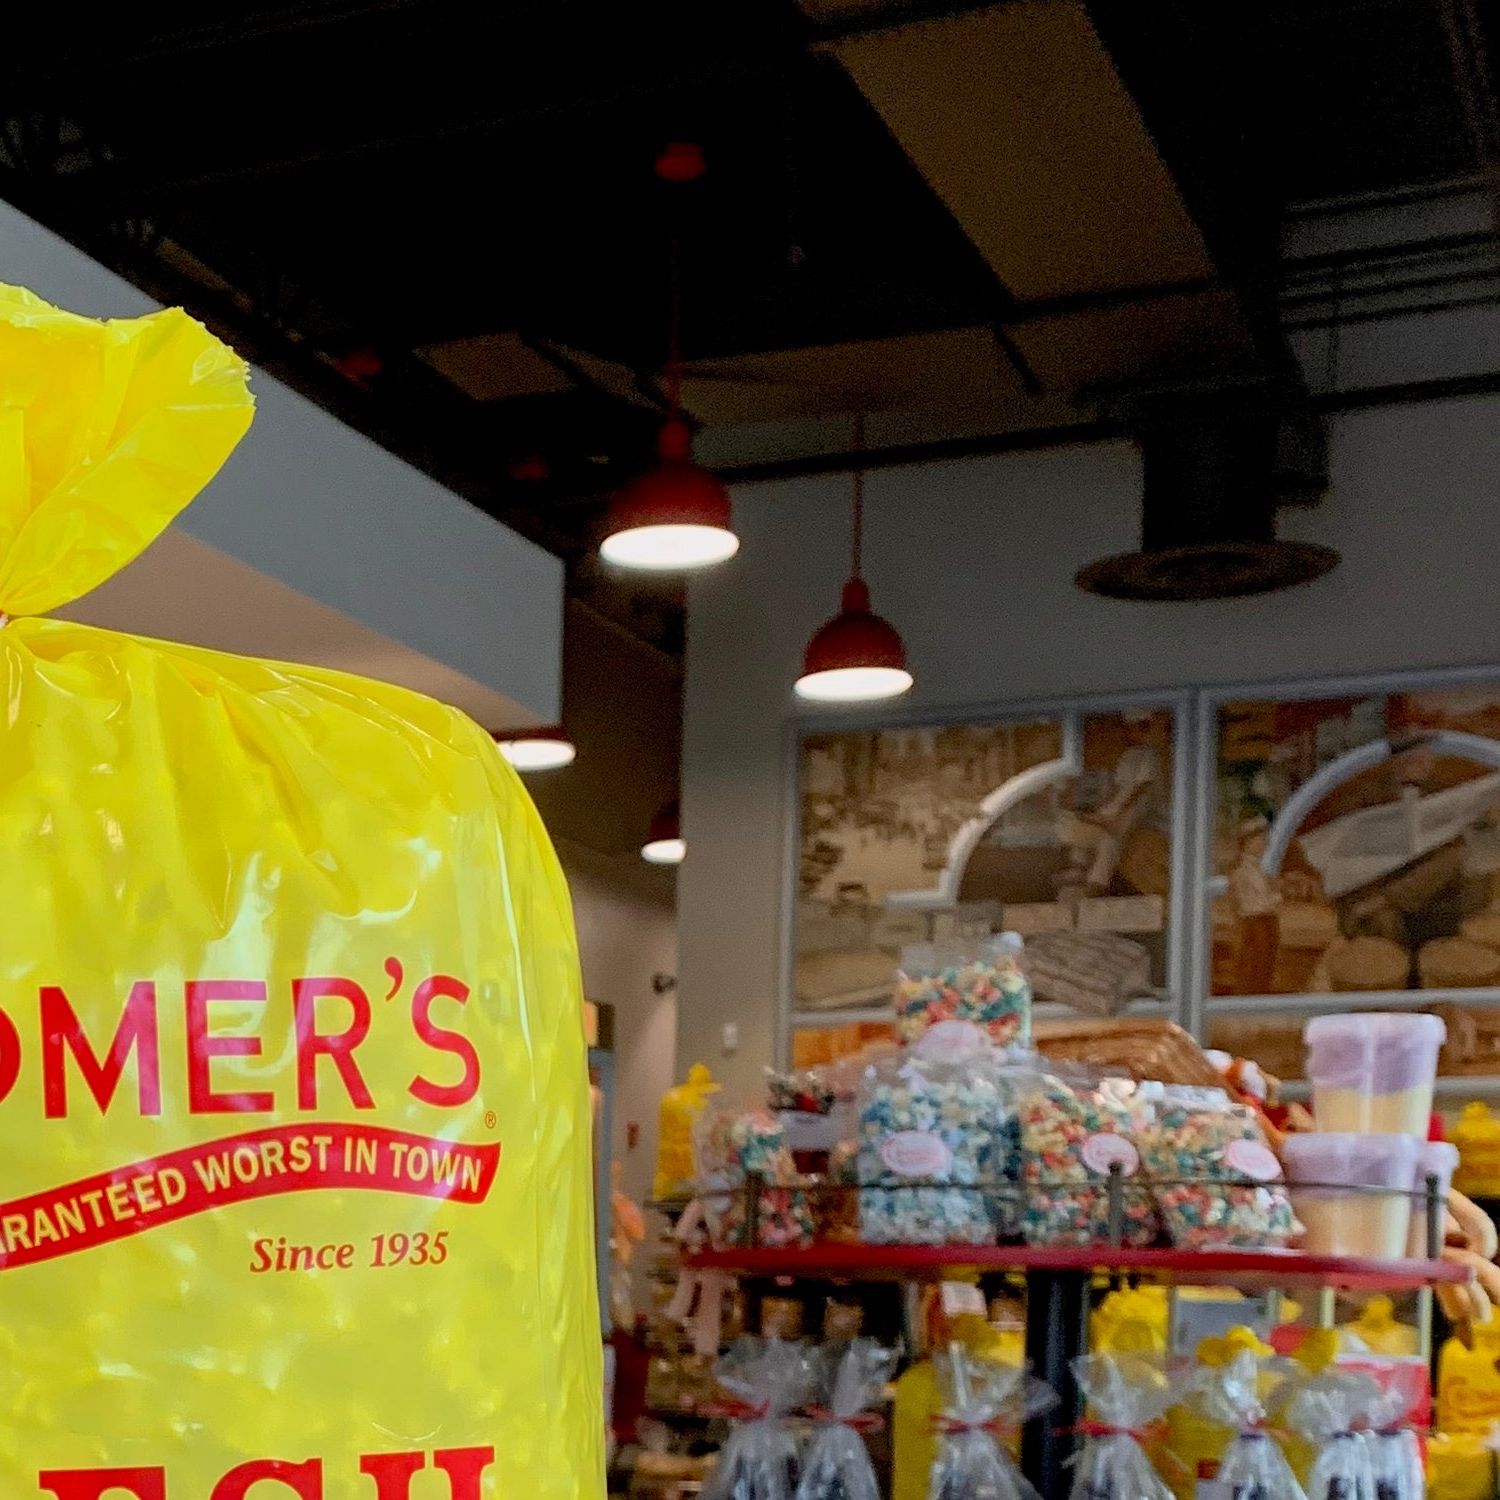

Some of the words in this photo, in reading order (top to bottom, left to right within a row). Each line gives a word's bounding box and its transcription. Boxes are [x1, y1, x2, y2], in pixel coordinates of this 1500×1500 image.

[192, 1135, 333, 1193] WORST
[343, 1136, 378, 1175] IN
[389, 1141, 482, 1193] TOWN
[249, 1236, 355, 1274] Since
[366, 1230, 450, 1267] 1935
